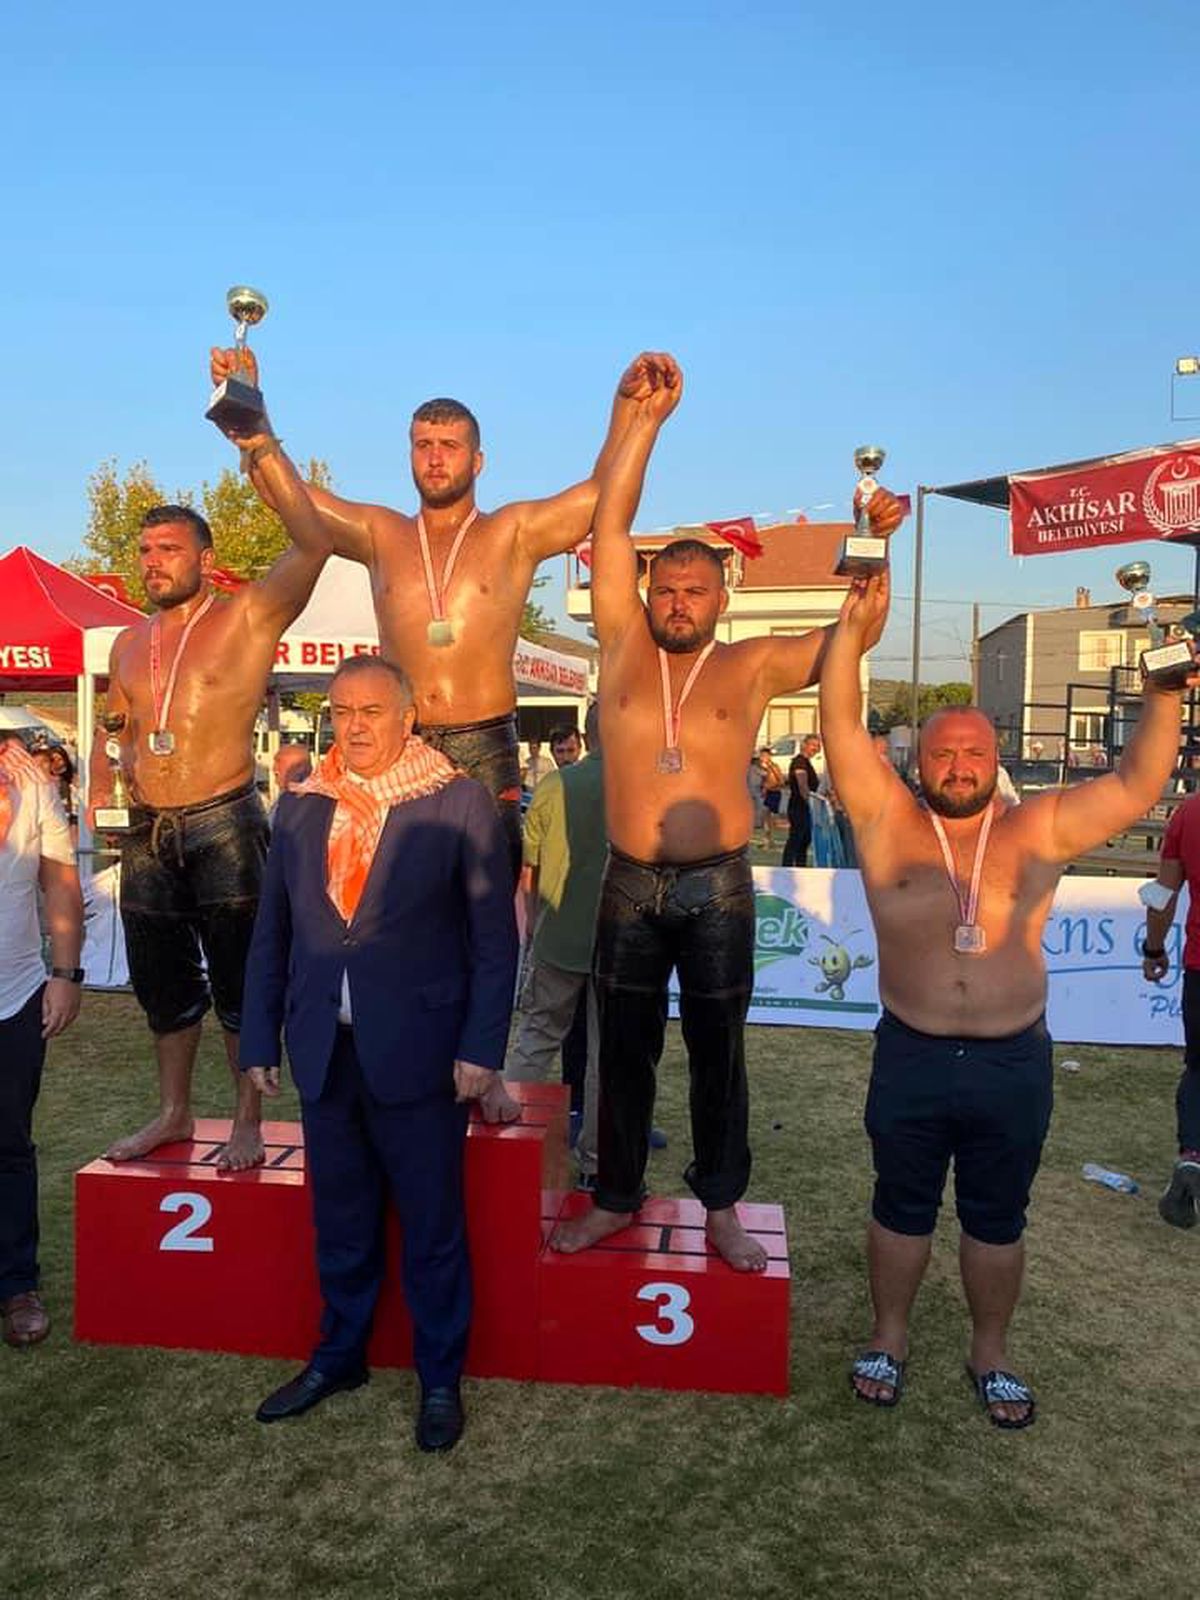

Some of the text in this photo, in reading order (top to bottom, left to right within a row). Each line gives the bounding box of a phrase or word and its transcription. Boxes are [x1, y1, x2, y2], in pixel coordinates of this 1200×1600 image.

[1027, 491, 1136, 528] AKHİSAR
[1038, 518, 1125, 543] BELEDİYESİ
[159, 1192, 214, 1251] 2
[635, 1282, 695, 1346] 3
